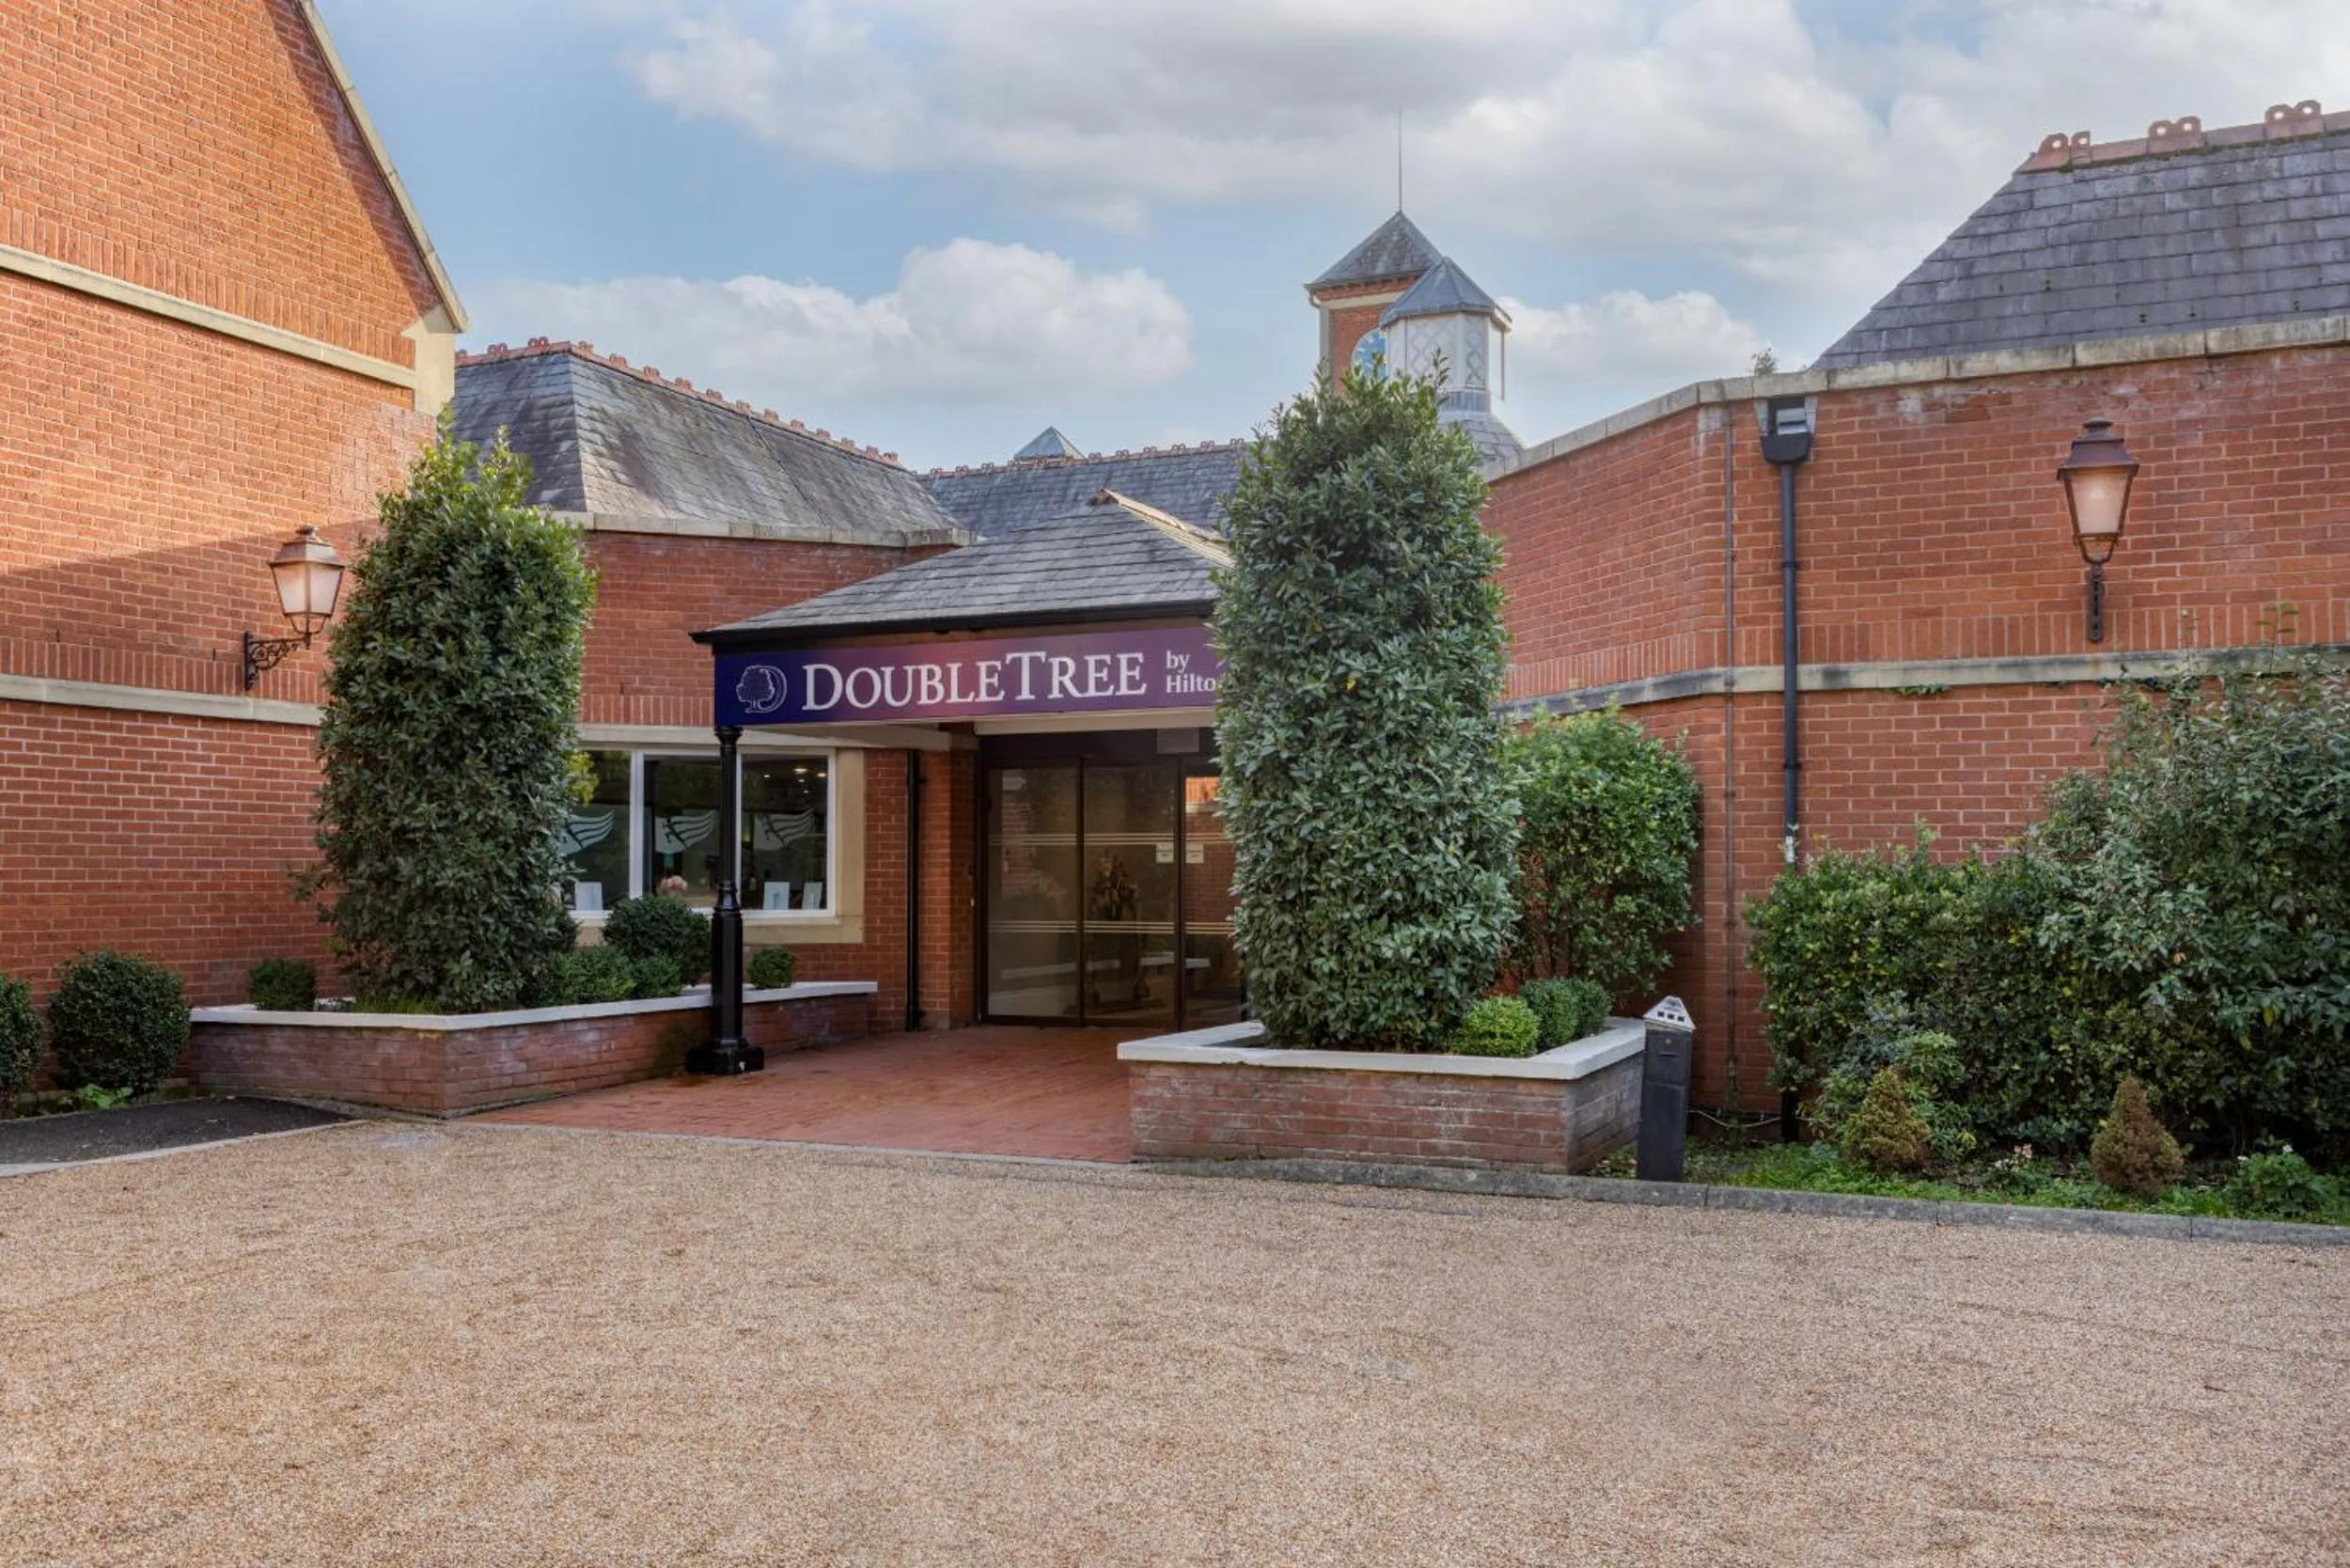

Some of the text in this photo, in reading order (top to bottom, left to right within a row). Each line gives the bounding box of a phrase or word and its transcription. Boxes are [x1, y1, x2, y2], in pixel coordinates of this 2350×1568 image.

[1166, 651, 1191, 673] by
[802, 651, 1148, 711] DOUBLETREE
[1166, 673, 1216, 693] Hilto
